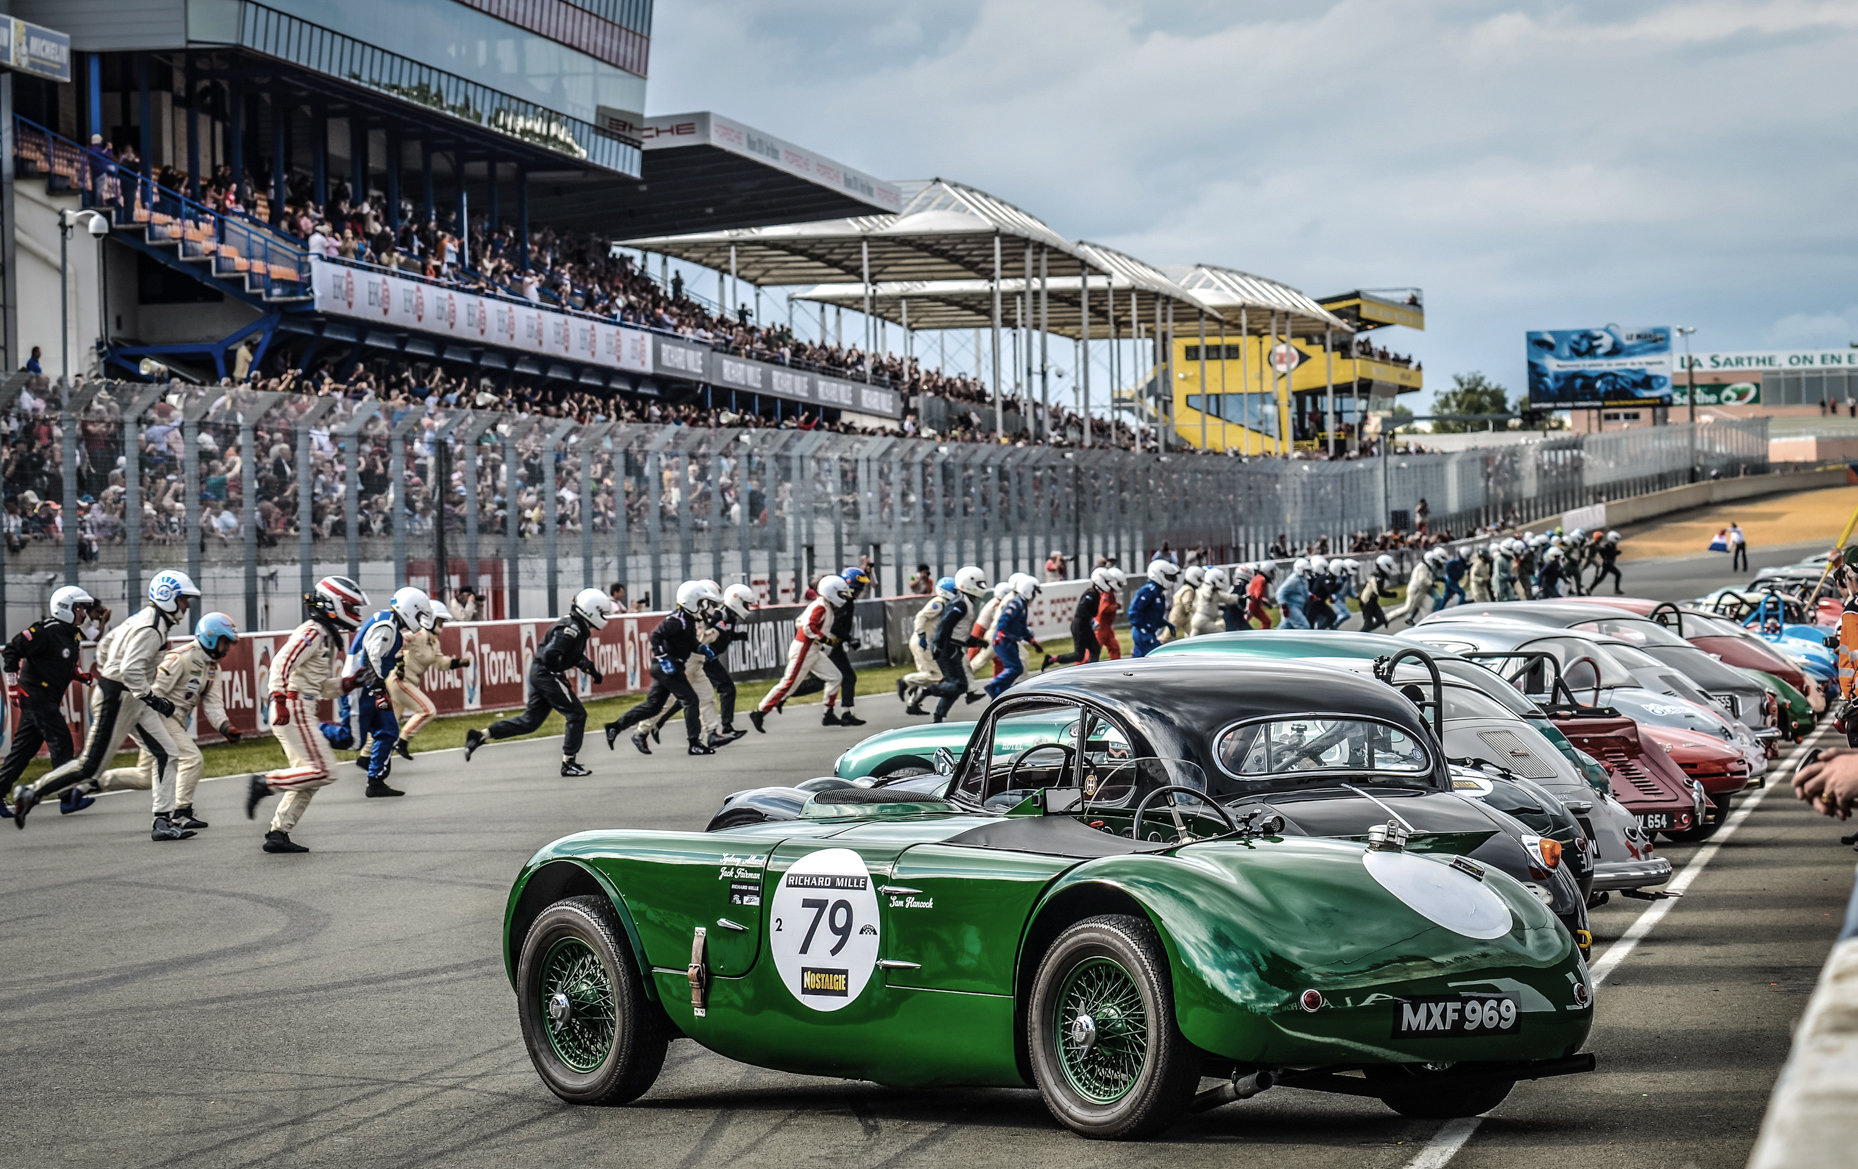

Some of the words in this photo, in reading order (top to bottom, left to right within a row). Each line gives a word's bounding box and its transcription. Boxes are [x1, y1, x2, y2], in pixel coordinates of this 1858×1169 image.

[1680, 355, 1703, 369] LA
[1709, 354, 1783, 369] SARTHE,
[1788, 354, 1814, 366] ON
[1820, 353, 1842, 365] EN
[1673, 388, 1718, 405] Sathe
[481, 643, 521, 686] TOTAL
[221, 671, 254, 710] TAL
[1647, 813, 1668, 829] 654
[719, 853, 742, 866] Sydney
[718, 867, 735, 880] Jack
[734, 868, 760, 879] Fairman
[788, 876, 831, 887] RICHARD
[835, 878, 866, 888] MILLE
[889, 895, 904, 908] Sam
[905, 896, 934, 908] Hancock
[775, 918, 783, 932] 2
[798, 898, 854, 957] 79
[803, 971, 846, 991] NOSTALGIE
[1401, 1001, 1461, 1032] MXF
[1464, 998, 1517, 1031] 969
